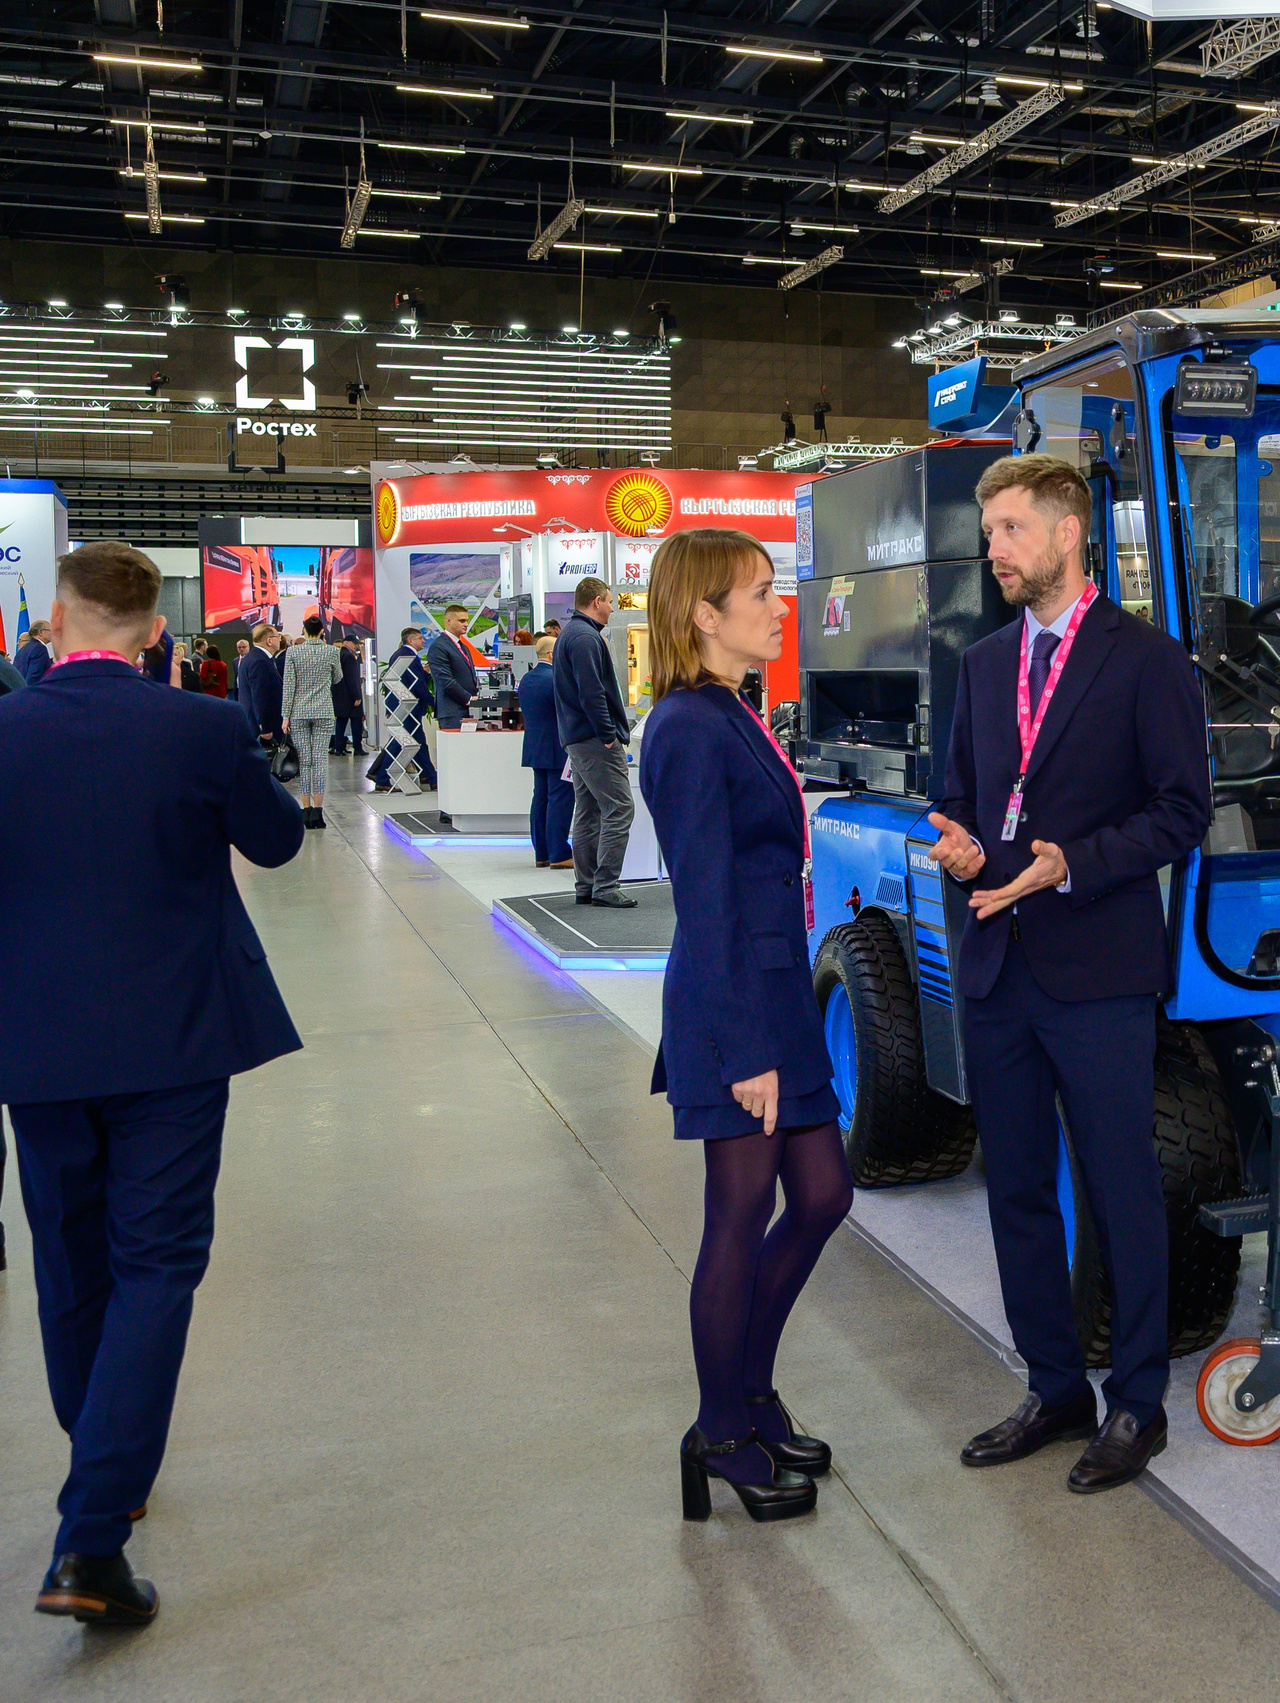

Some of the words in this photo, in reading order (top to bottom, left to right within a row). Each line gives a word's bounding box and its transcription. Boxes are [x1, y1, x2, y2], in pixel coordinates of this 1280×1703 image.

[236, 417, 317, 437] Ростех
[460, 499, 536, 517] РЕСПУБЛИКА
[681, 498, 778, 516] КЫРГЫЗСКАЯ
[867, 535, 923, 562] МИТРАКС
[813, 815, 860, 840] МИТРАКС
